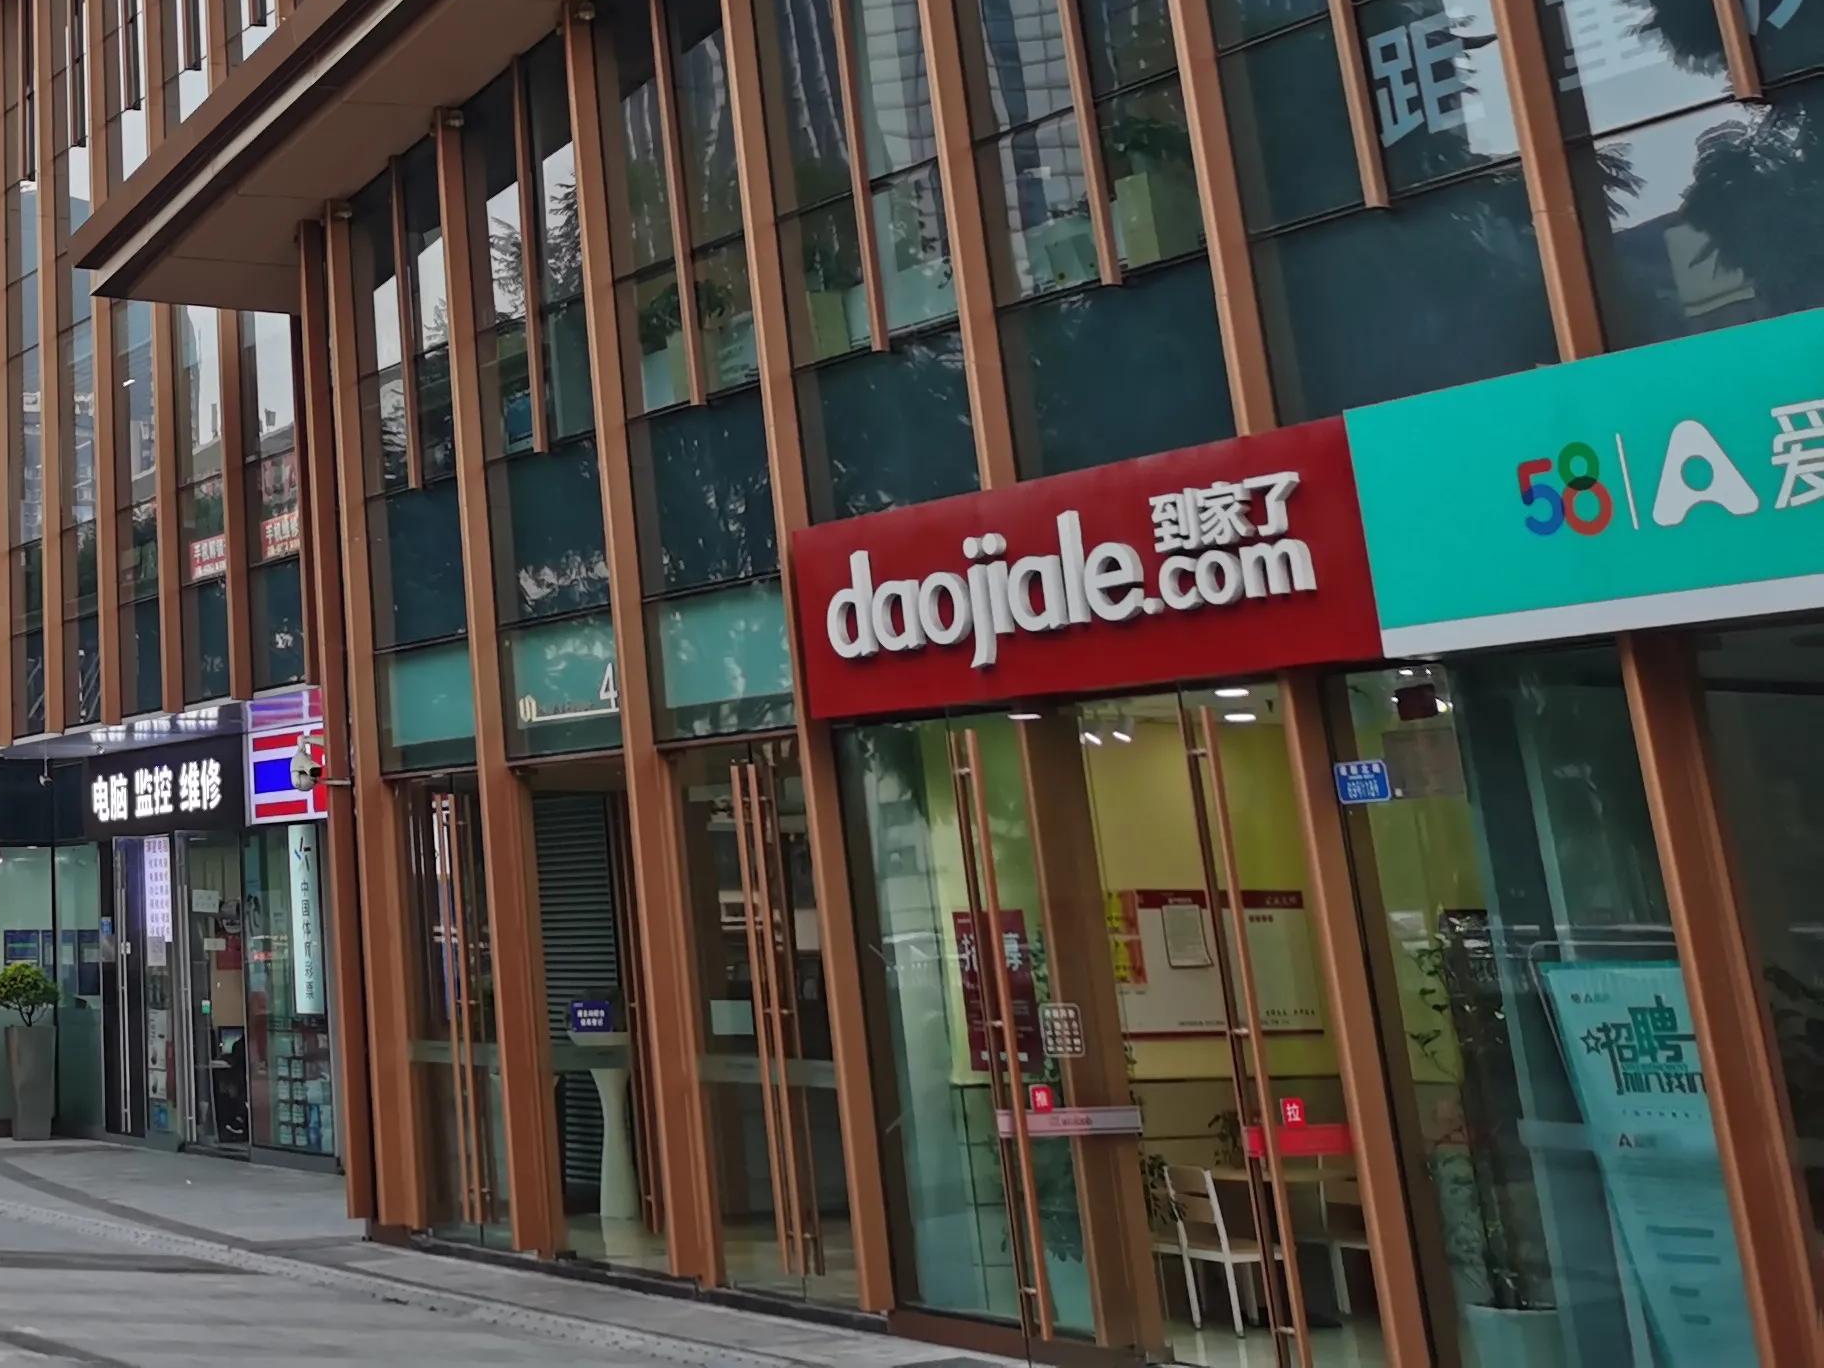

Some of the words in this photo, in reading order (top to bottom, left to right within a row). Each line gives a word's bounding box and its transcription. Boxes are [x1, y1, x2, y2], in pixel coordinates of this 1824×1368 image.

[1148, 470, 1300, 554] 到家了
[1517, 440, 1614, 537] 58
[826, 508, 1318, 670] daojiale.com
[599, 662, 618, 712] 4
[92, 774, 129, 823] 电脑
[134, 764, 174, 819] 监控
[179, 757, 222, 813] 维修
[299, 879, 315, 1000] 中国体育彩票
[1595, 994, 1697, 1096] 招聘
[1286, 1102, 1302, 1123] 拉
